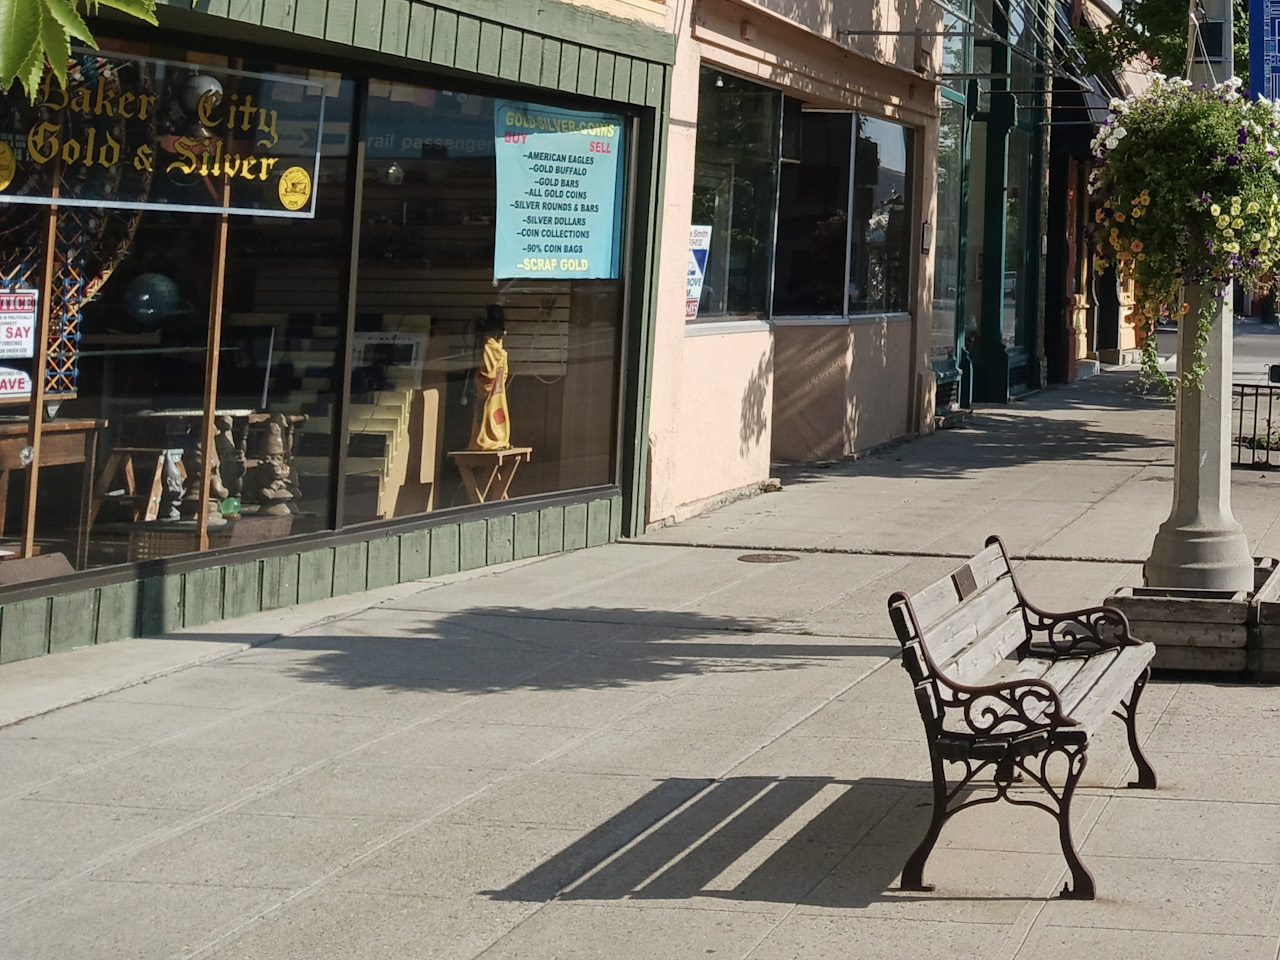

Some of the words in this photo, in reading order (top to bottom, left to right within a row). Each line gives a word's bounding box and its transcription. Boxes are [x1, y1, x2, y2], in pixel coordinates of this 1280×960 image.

[198, 88, 279, 148] City
[504, 132, 528, 144] BUY
[589, 141, 612, 154] SELL
[27, 121, 120, 169] Gold
[134, 146, 153, 172] &
[166, 134, 279, 181] Silver
[568, 155, 594, 165] EAGLES
[555, 166, 587, 176] BUFFALO
[560, 179, 579, 188] BARS
[544, 189, 564, 199] GOLD
[565, 190, 587, 200] COINS
[541, 202, 572, 212] ROUNDS
[573, 204, 579, 212] &
[580, 204, 599, 213] BARS
[554, 217, 586, 226] DOLLARS
[541, 229, 590, 239] COLLECTIONS
[544, 244, 562, 253] COIN
[563, 245, 583, 253] BAGS
[560, 258, 589, 271] GOLD
[0, 296, 34, 311] TICE
[5, 326, 31, 339] SAY
[0, 378, 25, 390] AVE
